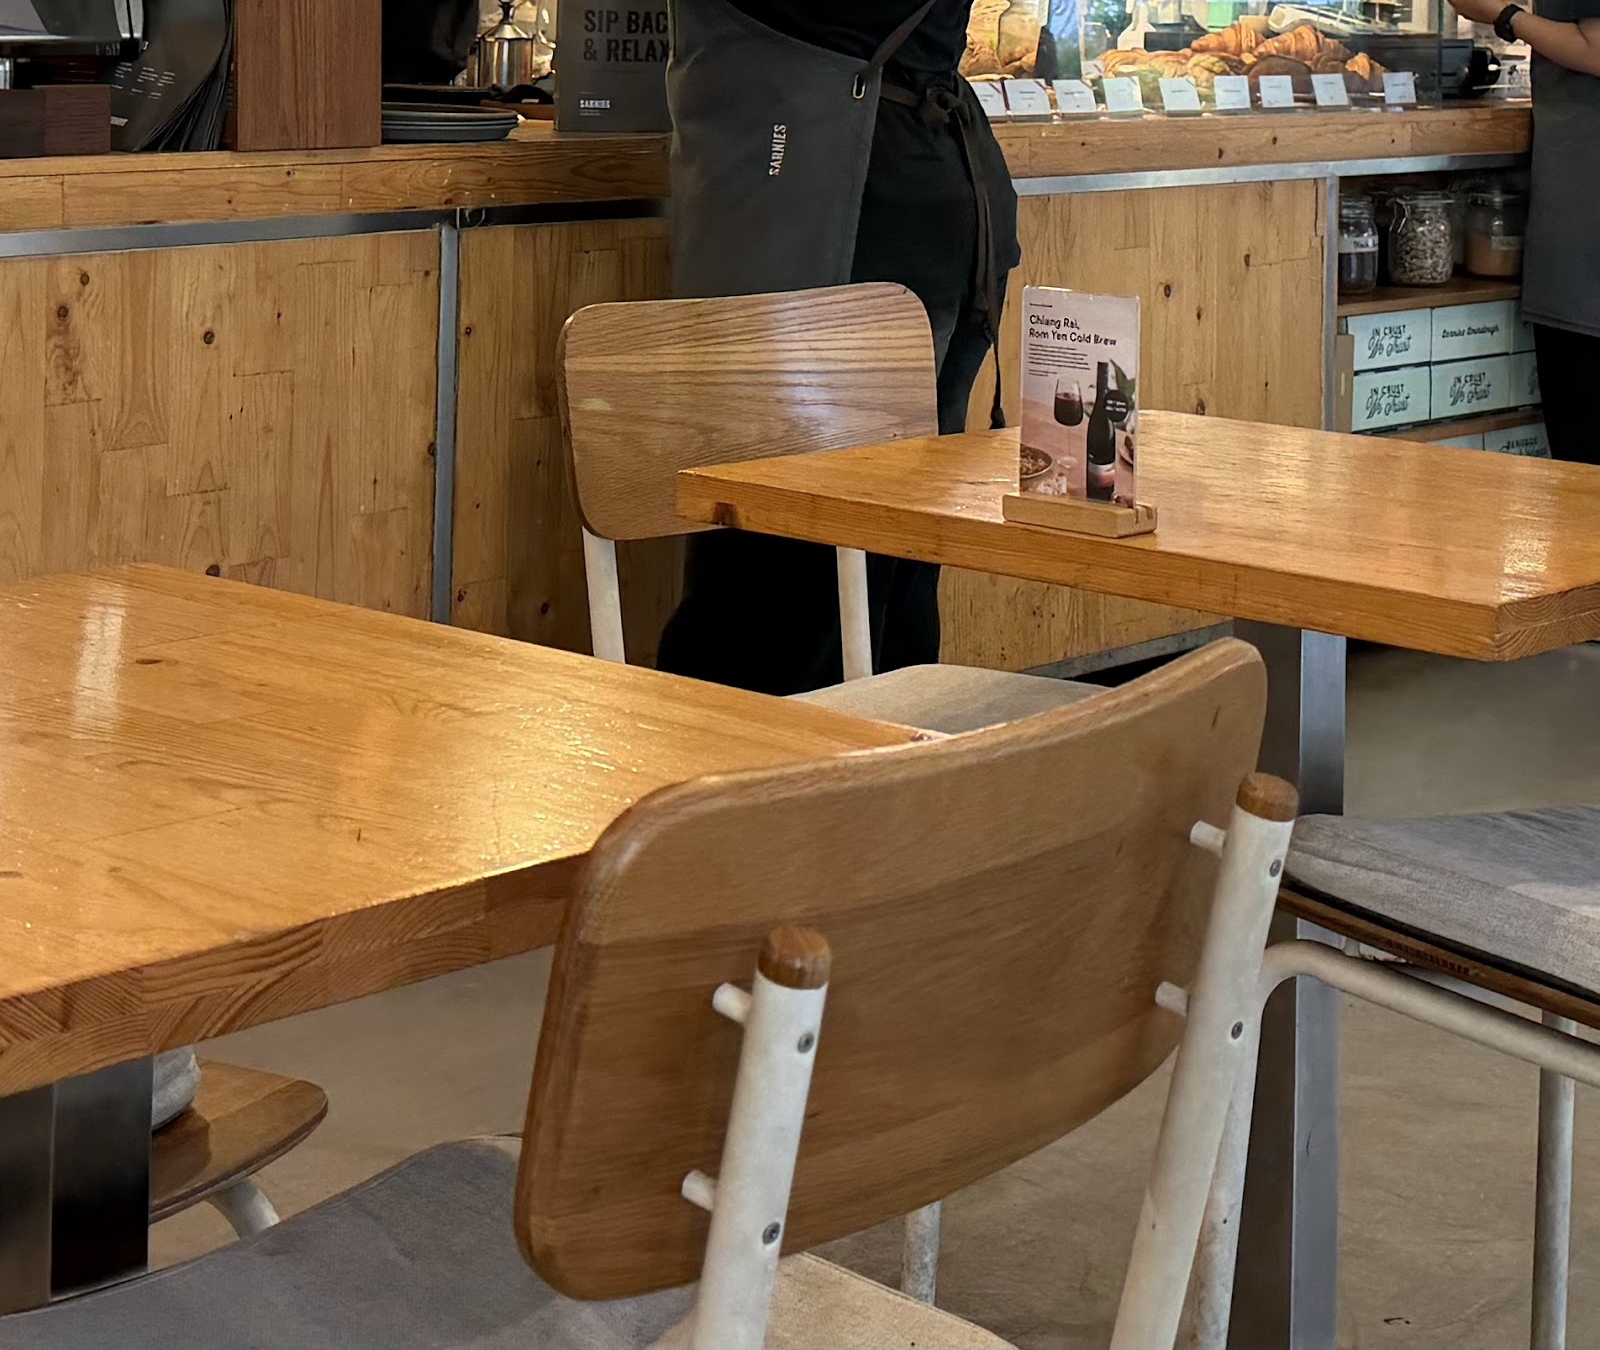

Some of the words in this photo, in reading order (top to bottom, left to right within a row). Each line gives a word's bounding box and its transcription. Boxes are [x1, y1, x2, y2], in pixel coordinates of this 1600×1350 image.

[583, 9, 619, 34] SIP
[626, 10, 669, 35] BAC
[583, 38, 597, 62] &
[605, 38, 671, 63] RELAX
[769, 123, 787, 176] SARNIES
[1029, 314, 1061, 330] Chiang
[1063, 317, 1080, 330] Rai,
[1383, 323, 1406, 337] CRUST
[1029, 327, 1049, 339] Rom
[1051, 329, 1067, 341] Yen
[1070, 332, 1091, 343] Cold
[1093, 334, 1117, 346] Brew
[1464, 372, 1486, 385] CRUST
[1381, 383, 1404, 396] CRUST
